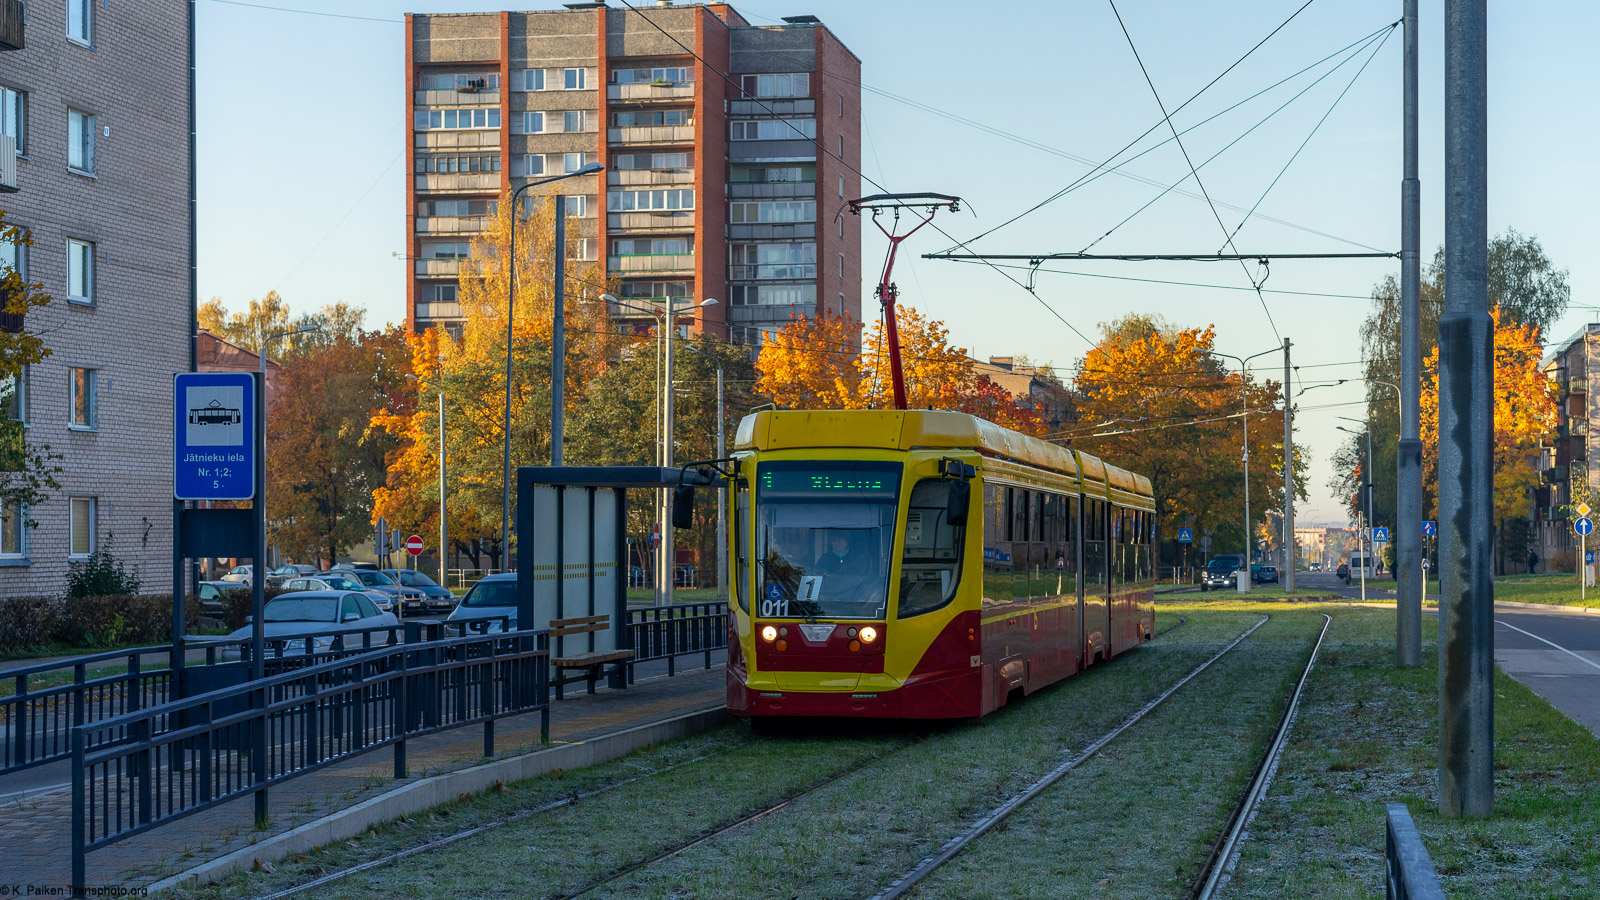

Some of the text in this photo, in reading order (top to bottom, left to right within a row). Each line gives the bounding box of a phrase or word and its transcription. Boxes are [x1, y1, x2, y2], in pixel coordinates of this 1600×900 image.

[184, 453, 244, 462] Jātnieku iela
[198, 468, 212, 477] Nr.
[806, 578, 816, 600] 1
[762, 599, 789, 617] 011
